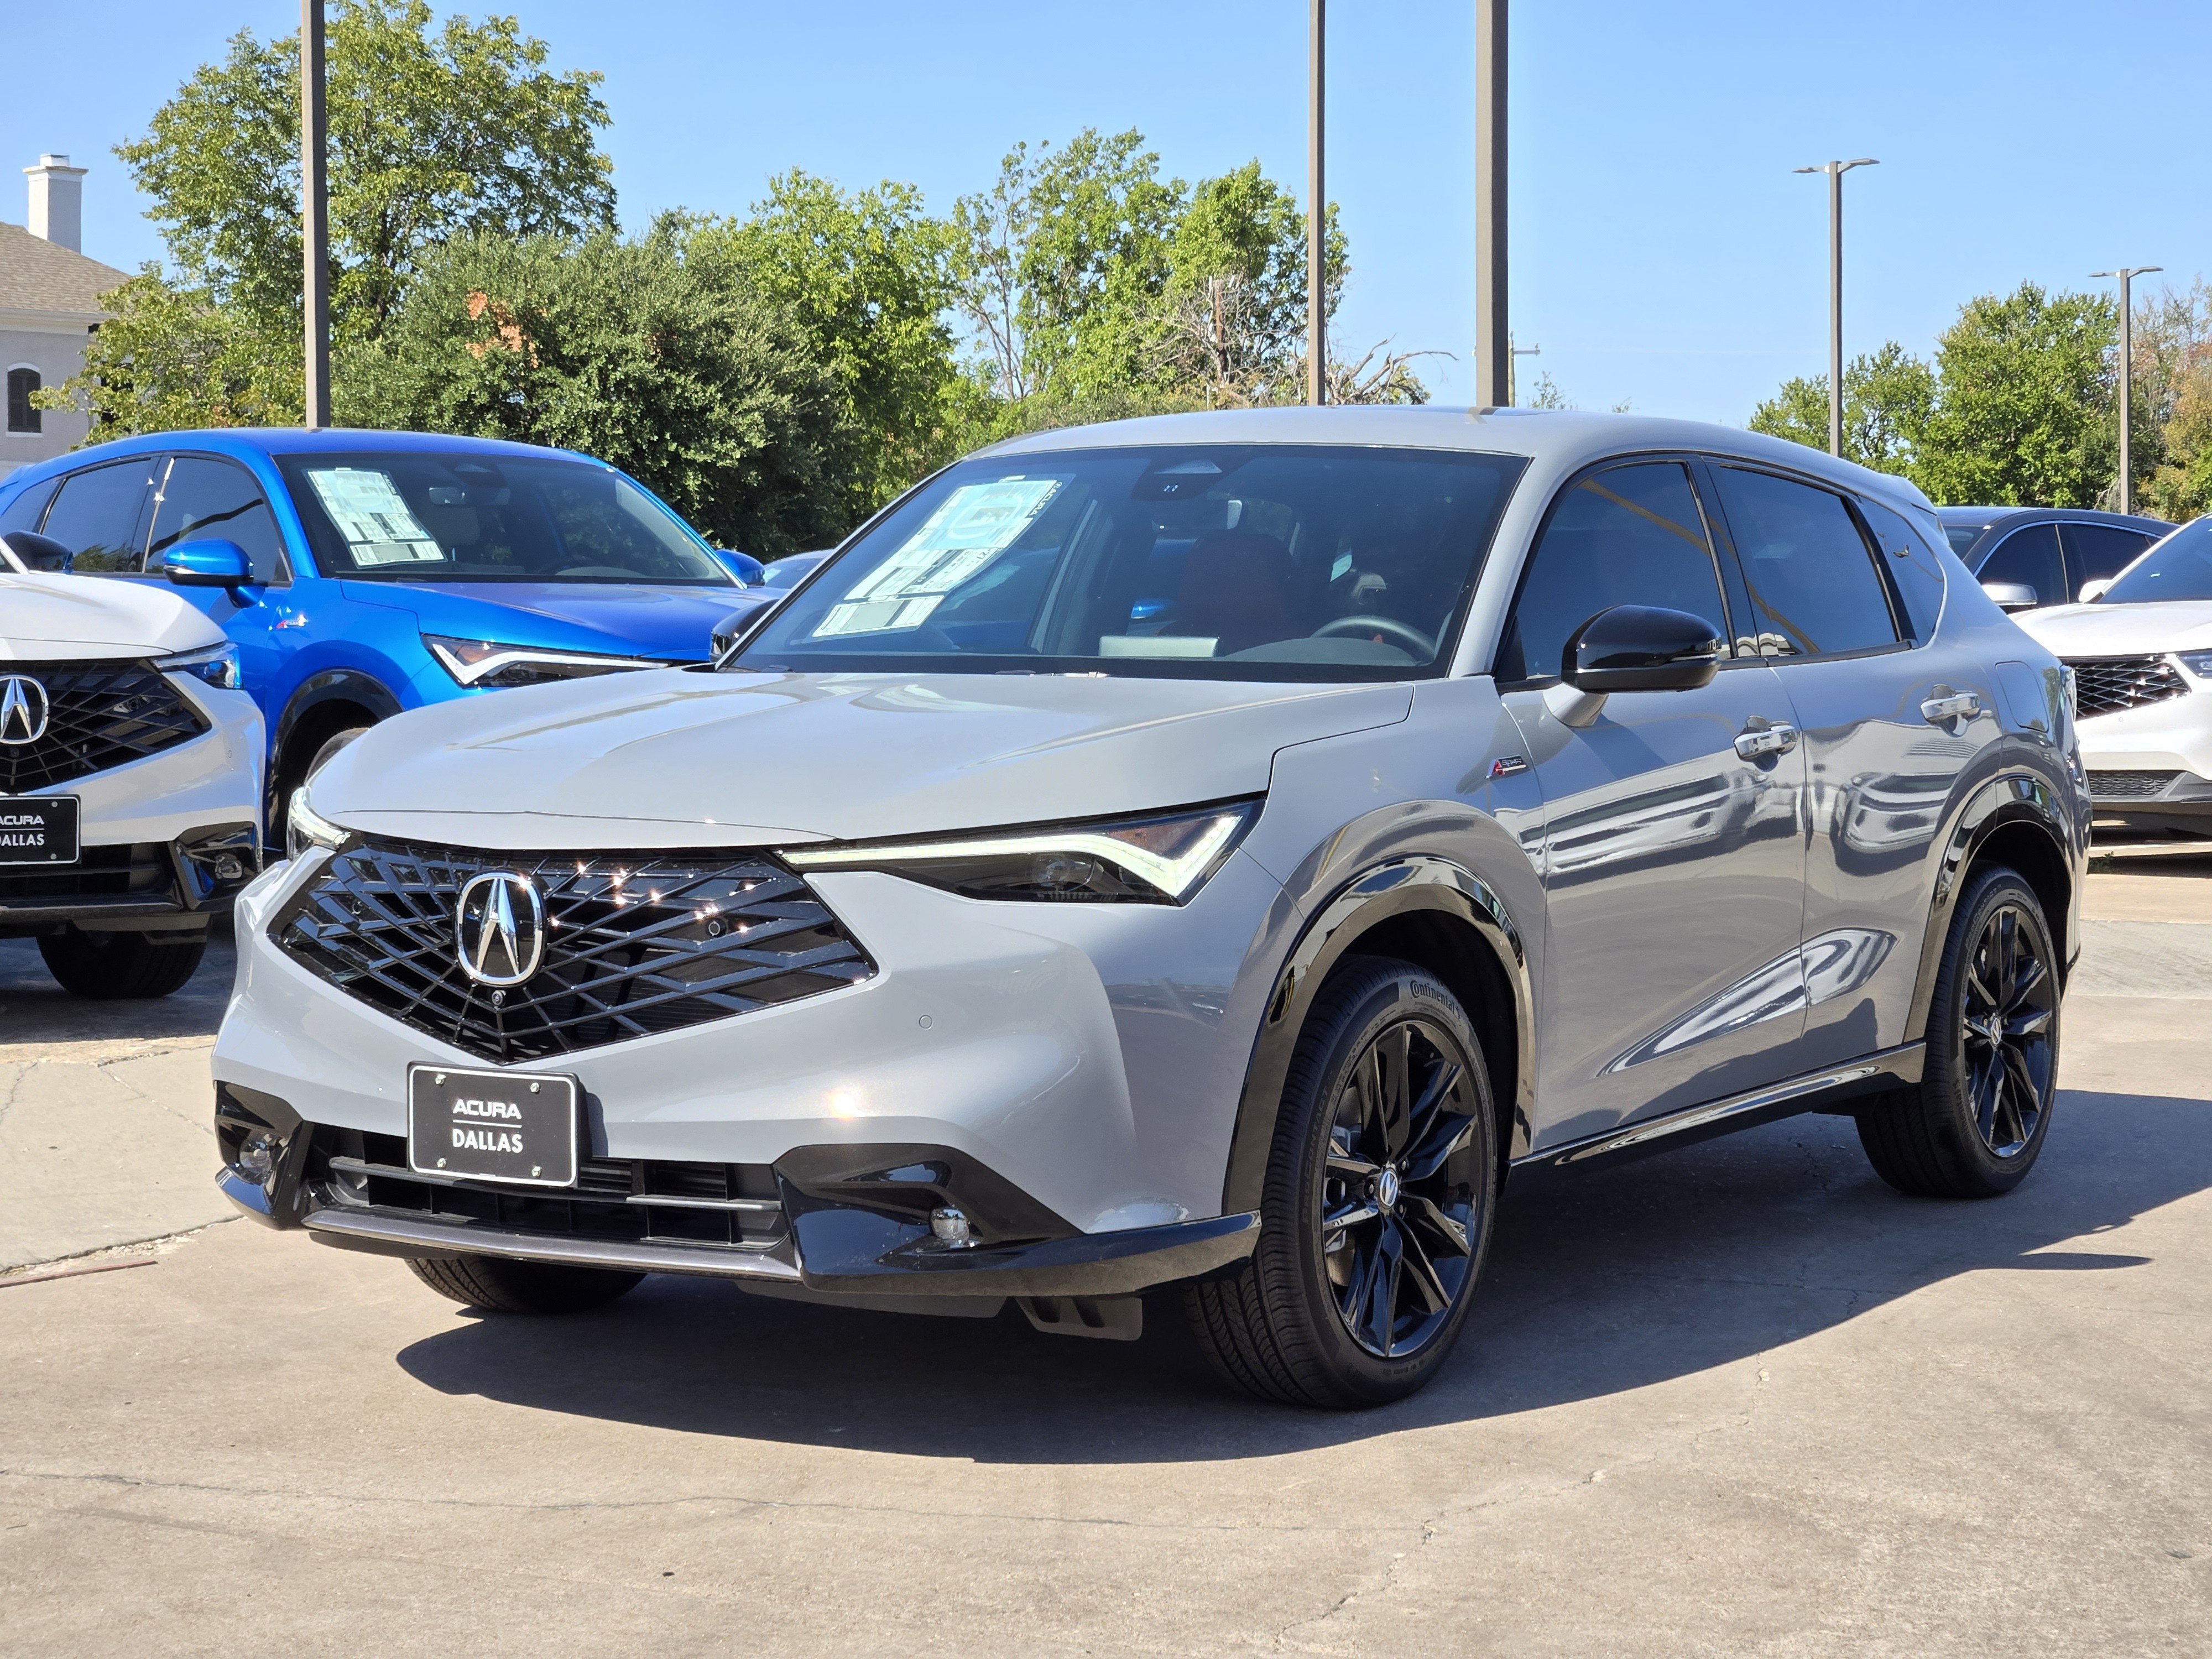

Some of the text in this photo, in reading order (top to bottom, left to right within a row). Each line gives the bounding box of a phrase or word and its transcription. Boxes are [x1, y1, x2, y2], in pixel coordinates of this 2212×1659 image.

[1029, 488, 1057, 516] ACURA
[0, 833, 45, 846] ALLAS
[1410, 980, 1455, 1013] Continental
[453, 1099, 522, 1119] ACURA
[453, 1129, 523, 1154] DALLAS
